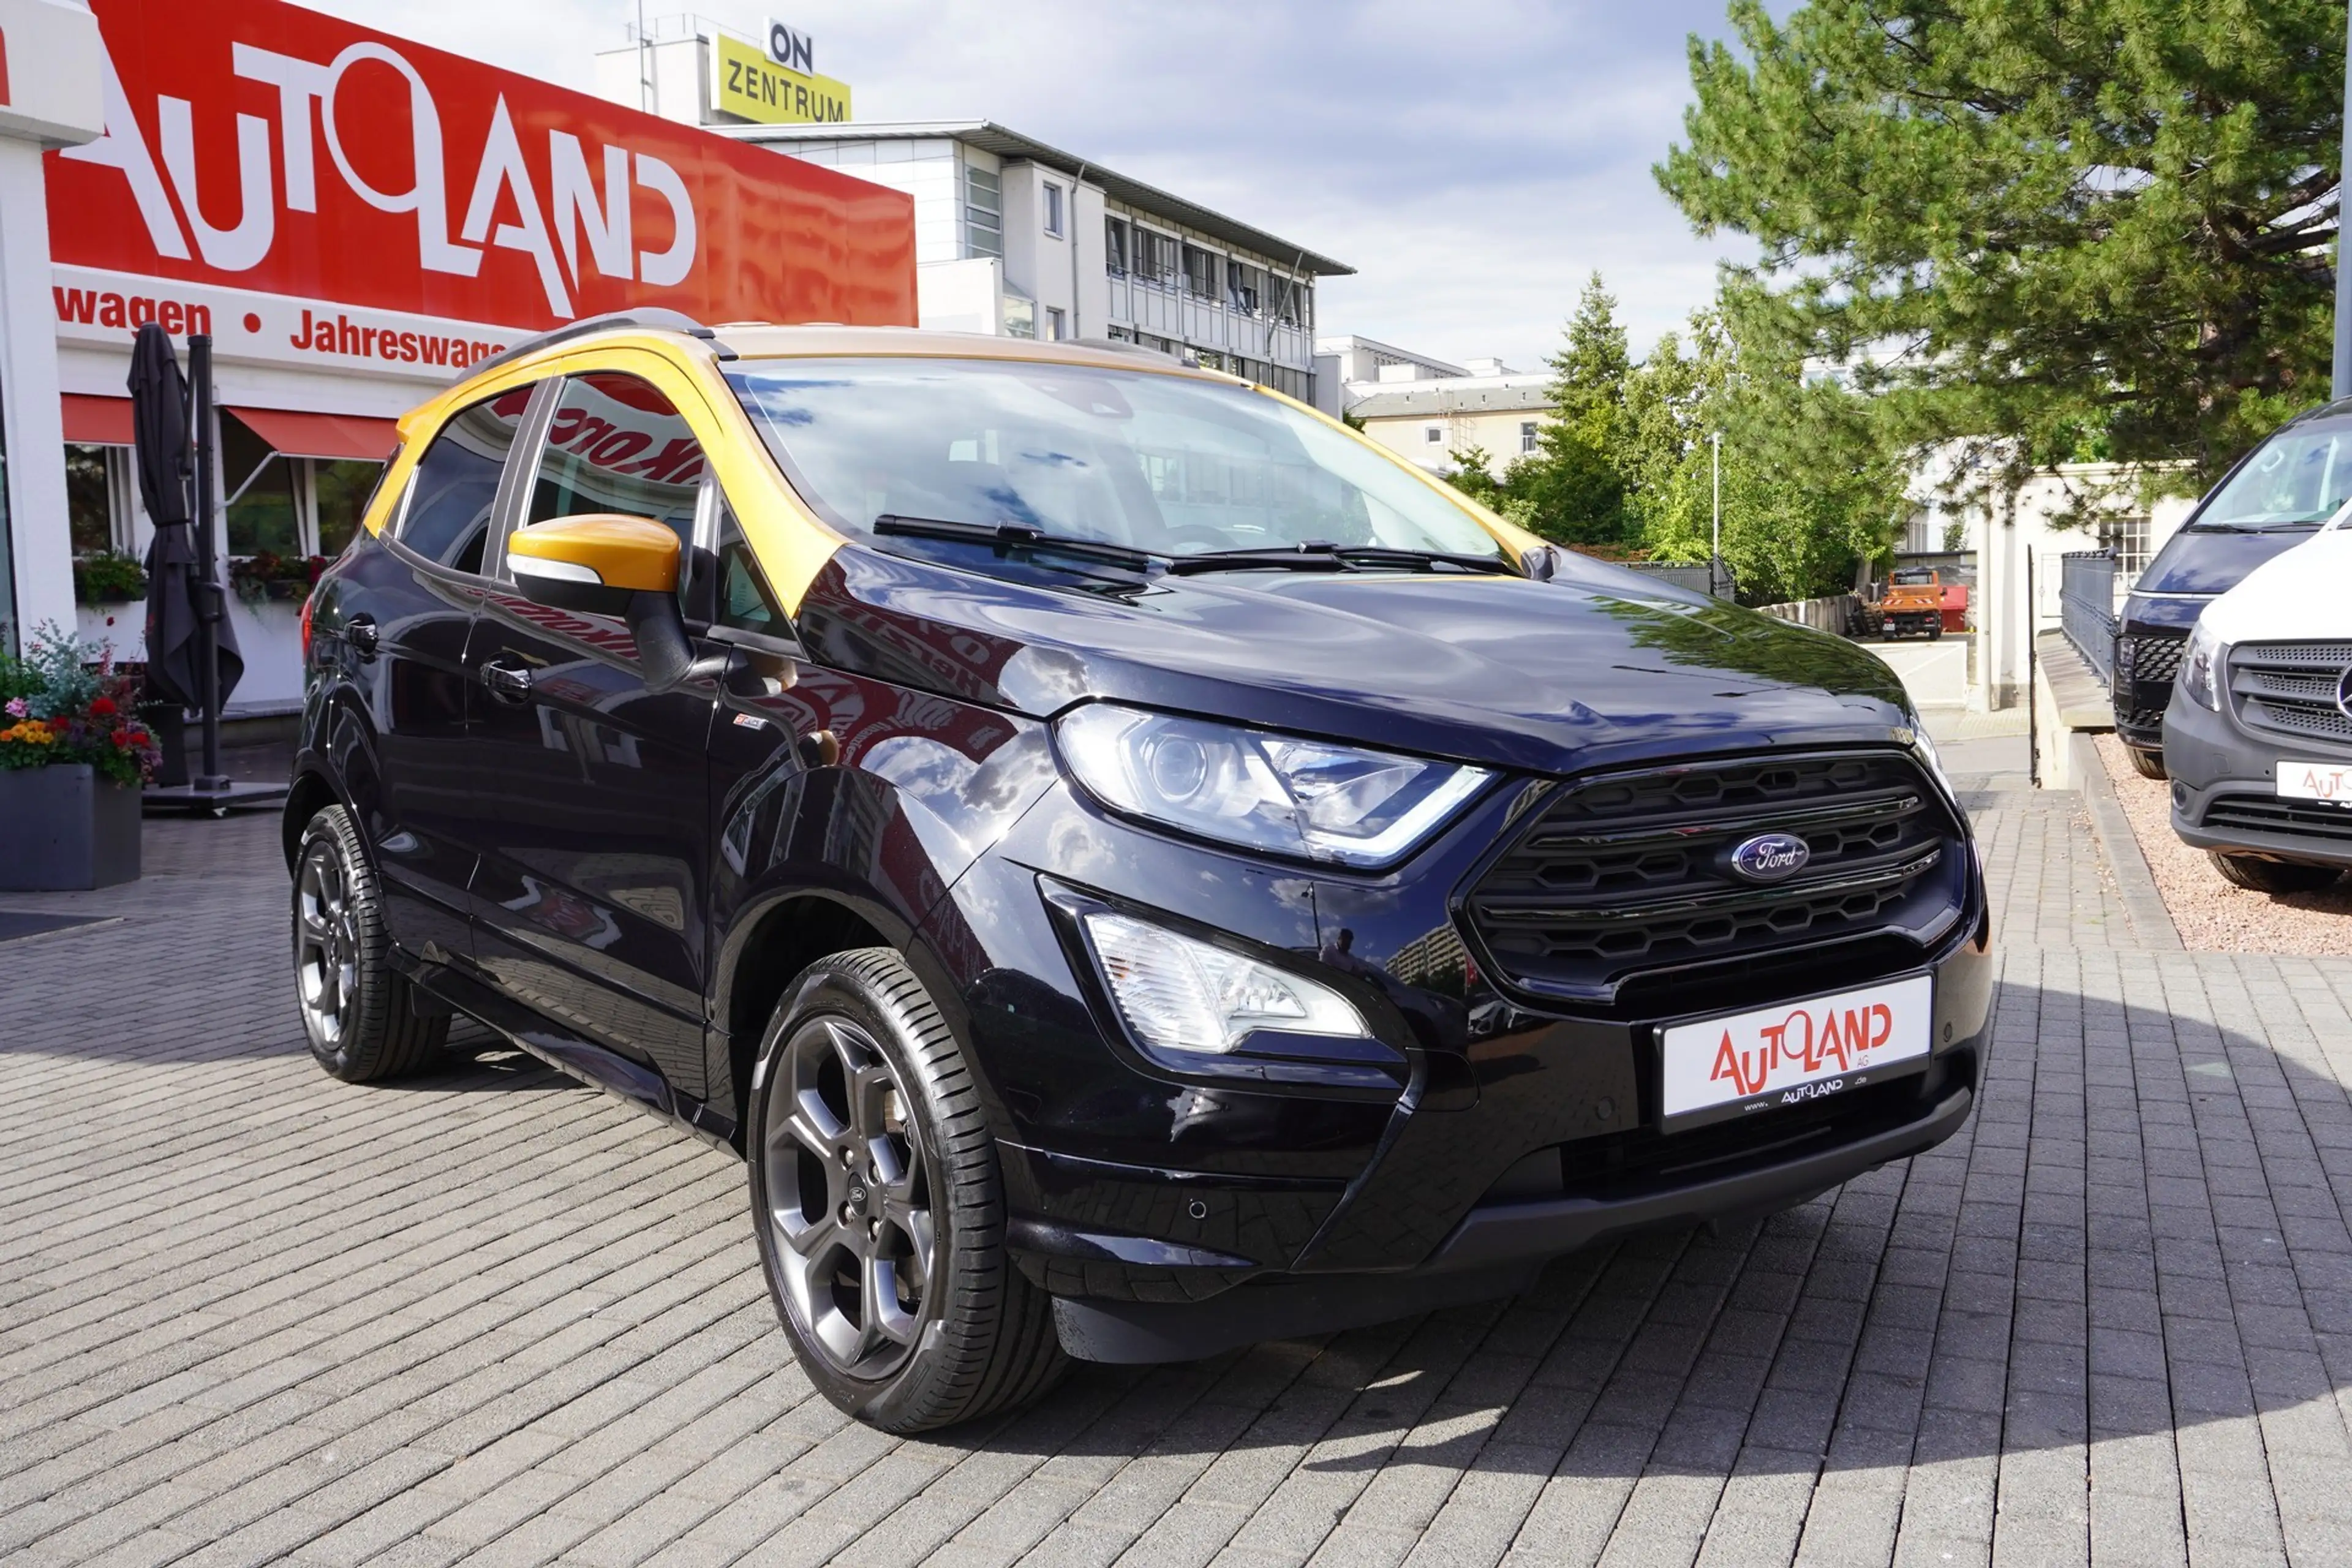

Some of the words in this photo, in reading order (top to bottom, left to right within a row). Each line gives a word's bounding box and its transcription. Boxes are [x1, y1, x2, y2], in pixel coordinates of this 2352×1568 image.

[770, 23, 812, 74] ON
[728, 58, 843, 123] ZENTRUM
[1755, 842, 1796, 870] Ford
[1857, 1055, 1869, 1068] AG
[1744, 1101, 1768, 1111] www.
